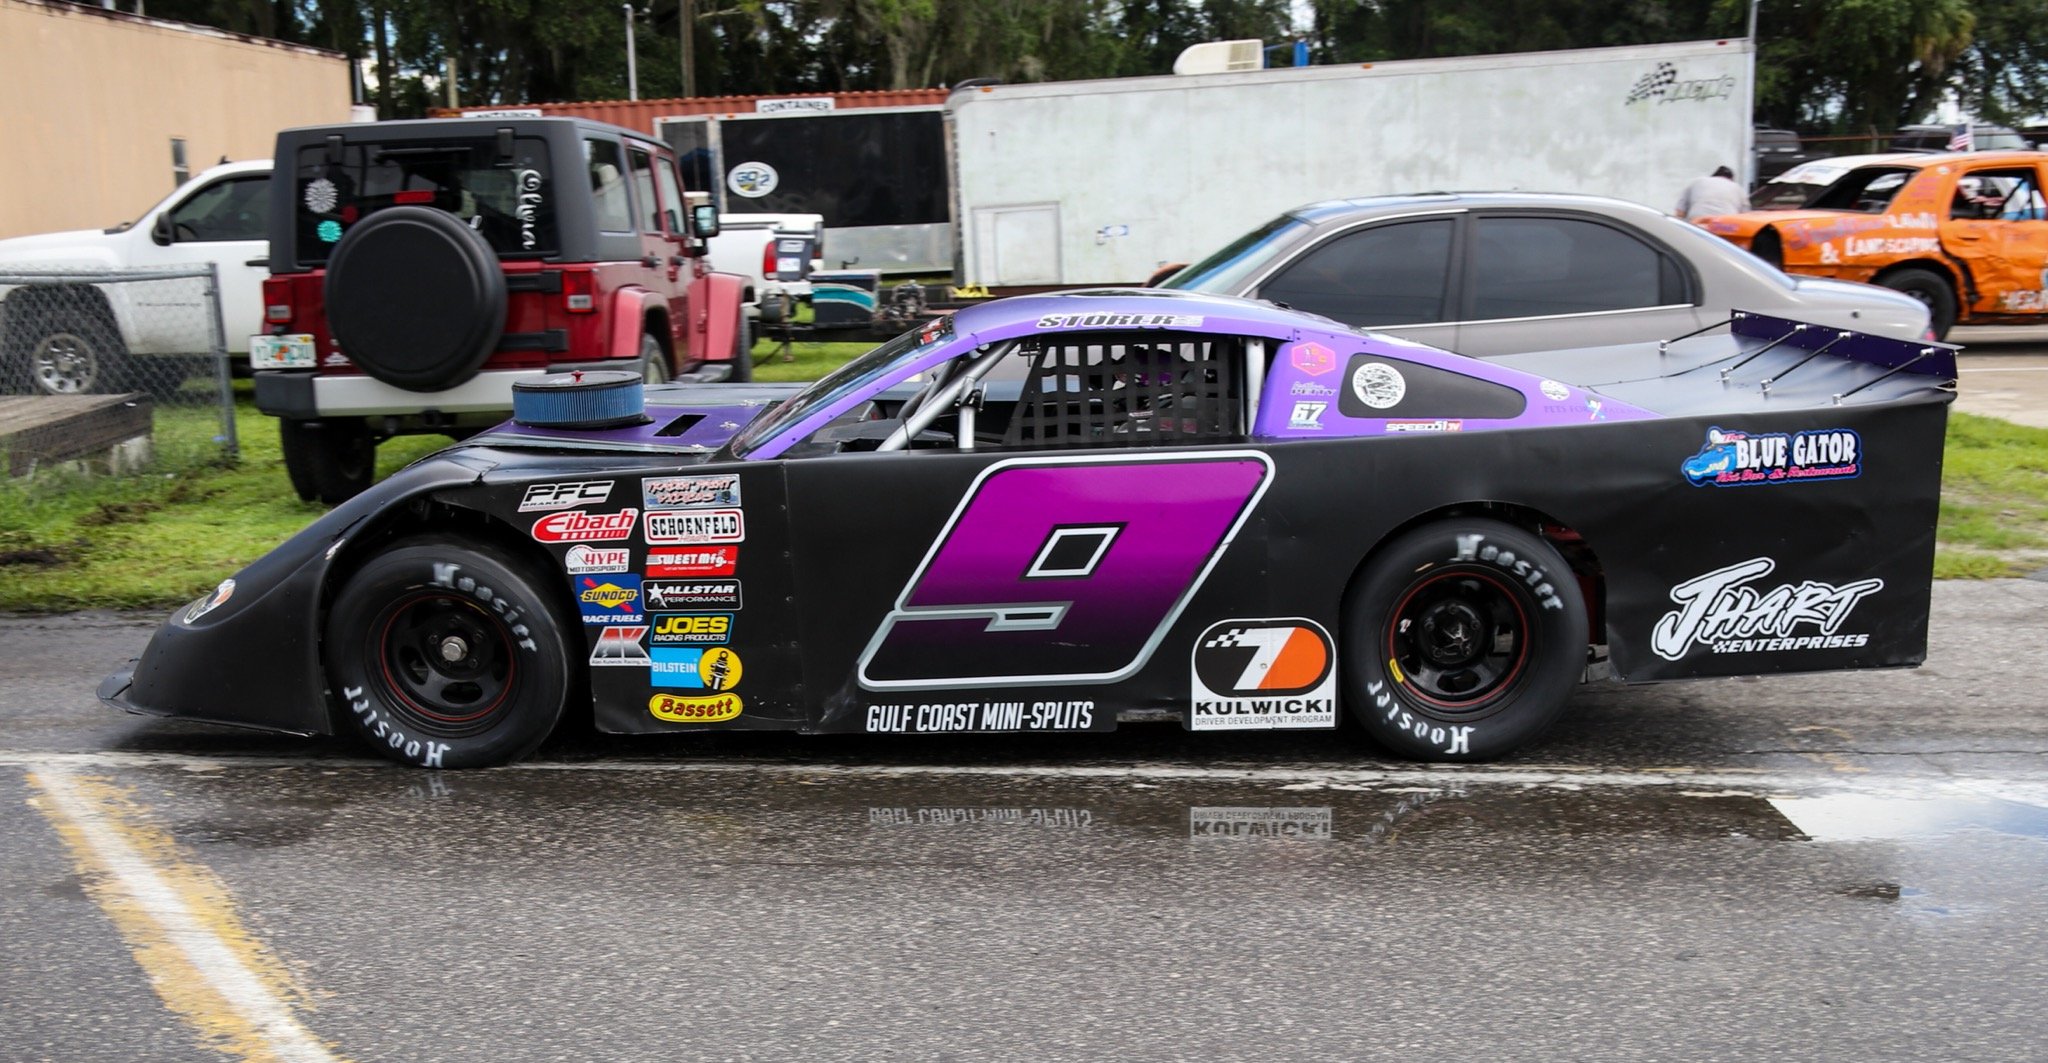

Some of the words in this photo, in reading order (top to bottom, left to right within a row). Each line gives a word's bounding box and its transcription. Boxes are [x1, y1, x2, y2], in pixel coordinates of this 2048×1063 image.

[1735, 437, 1788, 471] BLUE
[1792, 433, 1857, 468] GATOR
[524, 482, 612, 502] PFC
[533, 510, 635, 541] Eibach
[651, 516, 737, 536] SCHOENFELD
[585, 552, 628, 565] HYPE
[657, 553, 698, 565] SWEET
[569, 565, 627, 573] MOTORSPORTS
[858, 449, 1276, 691] 9
[1450, 534, 1564, 610] Hoosier
[583, 590, 635, 601] SUNOCO
[662, 585, 737, 595] ALLSTAR
[664, 595, 737, 603] PERFORMANCE
[582, 614, 611, 623] RACE
[611, 614, 643, 623] FUELS
[655, 616, 729, 634] JOES
[653, 634, 683, 642] RACING
[683, 633, 726, 642] PRODUCTS
[1727, 633, 1870, 654] ENTERPRISES
[652, 662, 698, 674] BILSTEIN
[659, 697, 733, 717] Bassett
[1195, 698, 1333, 716] KULWICKI
[865, 705, 914, 733] GULF
[915, 703, 980, 732] COAST
[980, 700, 1095, 731] MINI-SPLITS
[1195, 717, 1226, 726] DRIVER
[1227, 715, 1288, 726] DEVELOPMENT
[1290, 714, 1333, 724] PROGRAM
[1366, 679, 1476, 754] Hoosier
[343, 686, 452, 769] Hoosier
